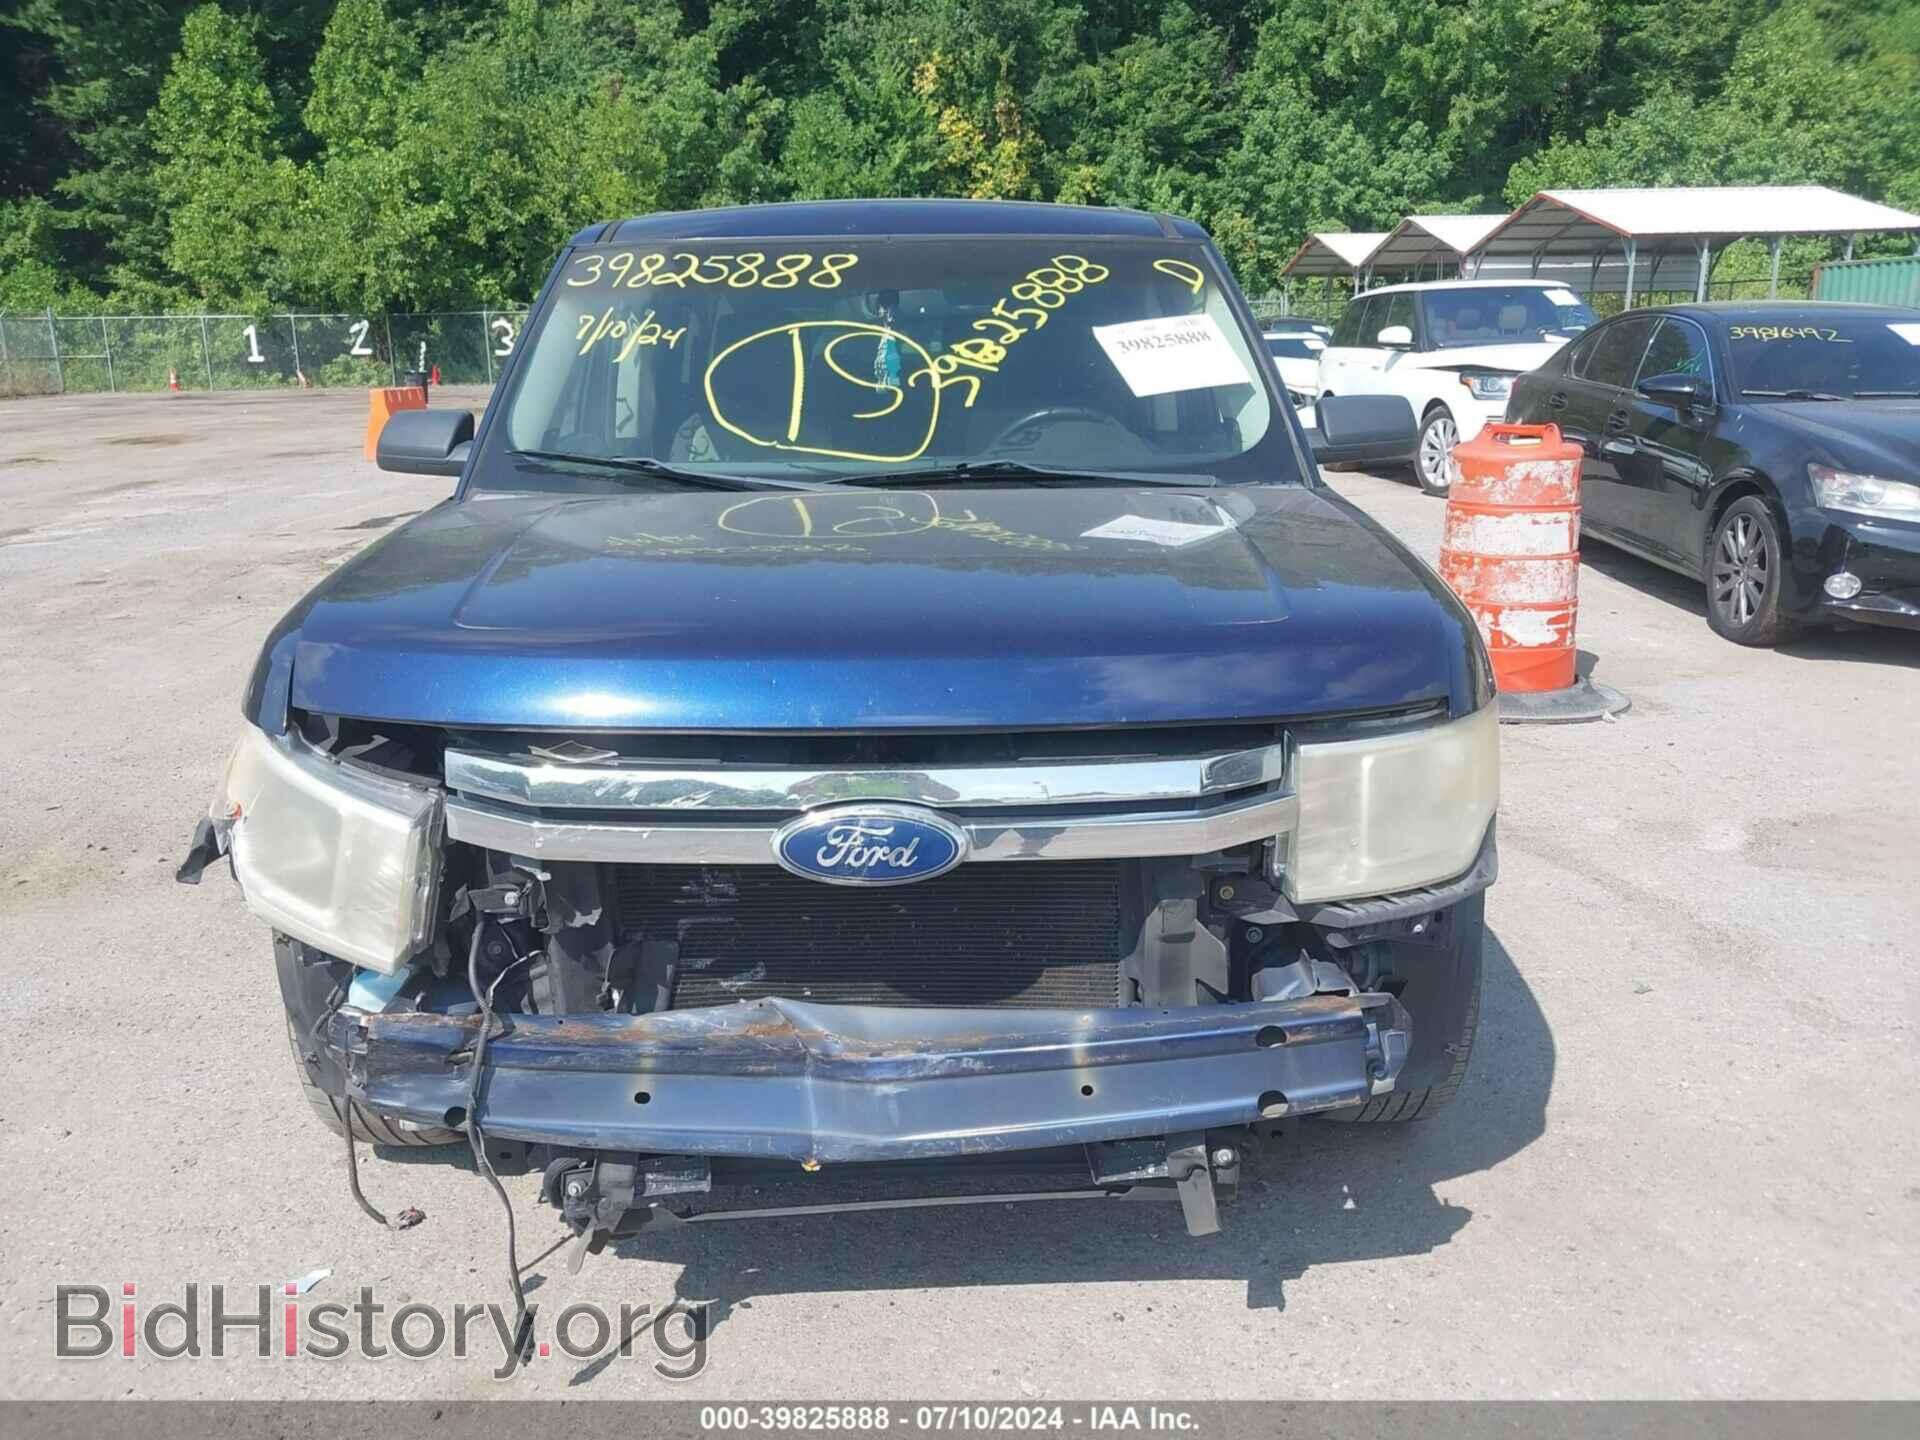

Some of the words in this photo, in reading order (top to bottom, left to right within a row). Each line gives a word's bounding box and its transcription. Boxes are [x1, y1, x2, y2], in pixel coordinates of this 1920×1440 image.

[566, 253, 859, 289] 39825888
[243, 325, 265, 362] 1
[349, 320, 373, 355] 2
[491, 317, 514, 356] 3
[575, 306, 687, 364] 7/10/24
[1116, 332, 1211, 354] 39825888
[815, 823, 921, 868] Ford
